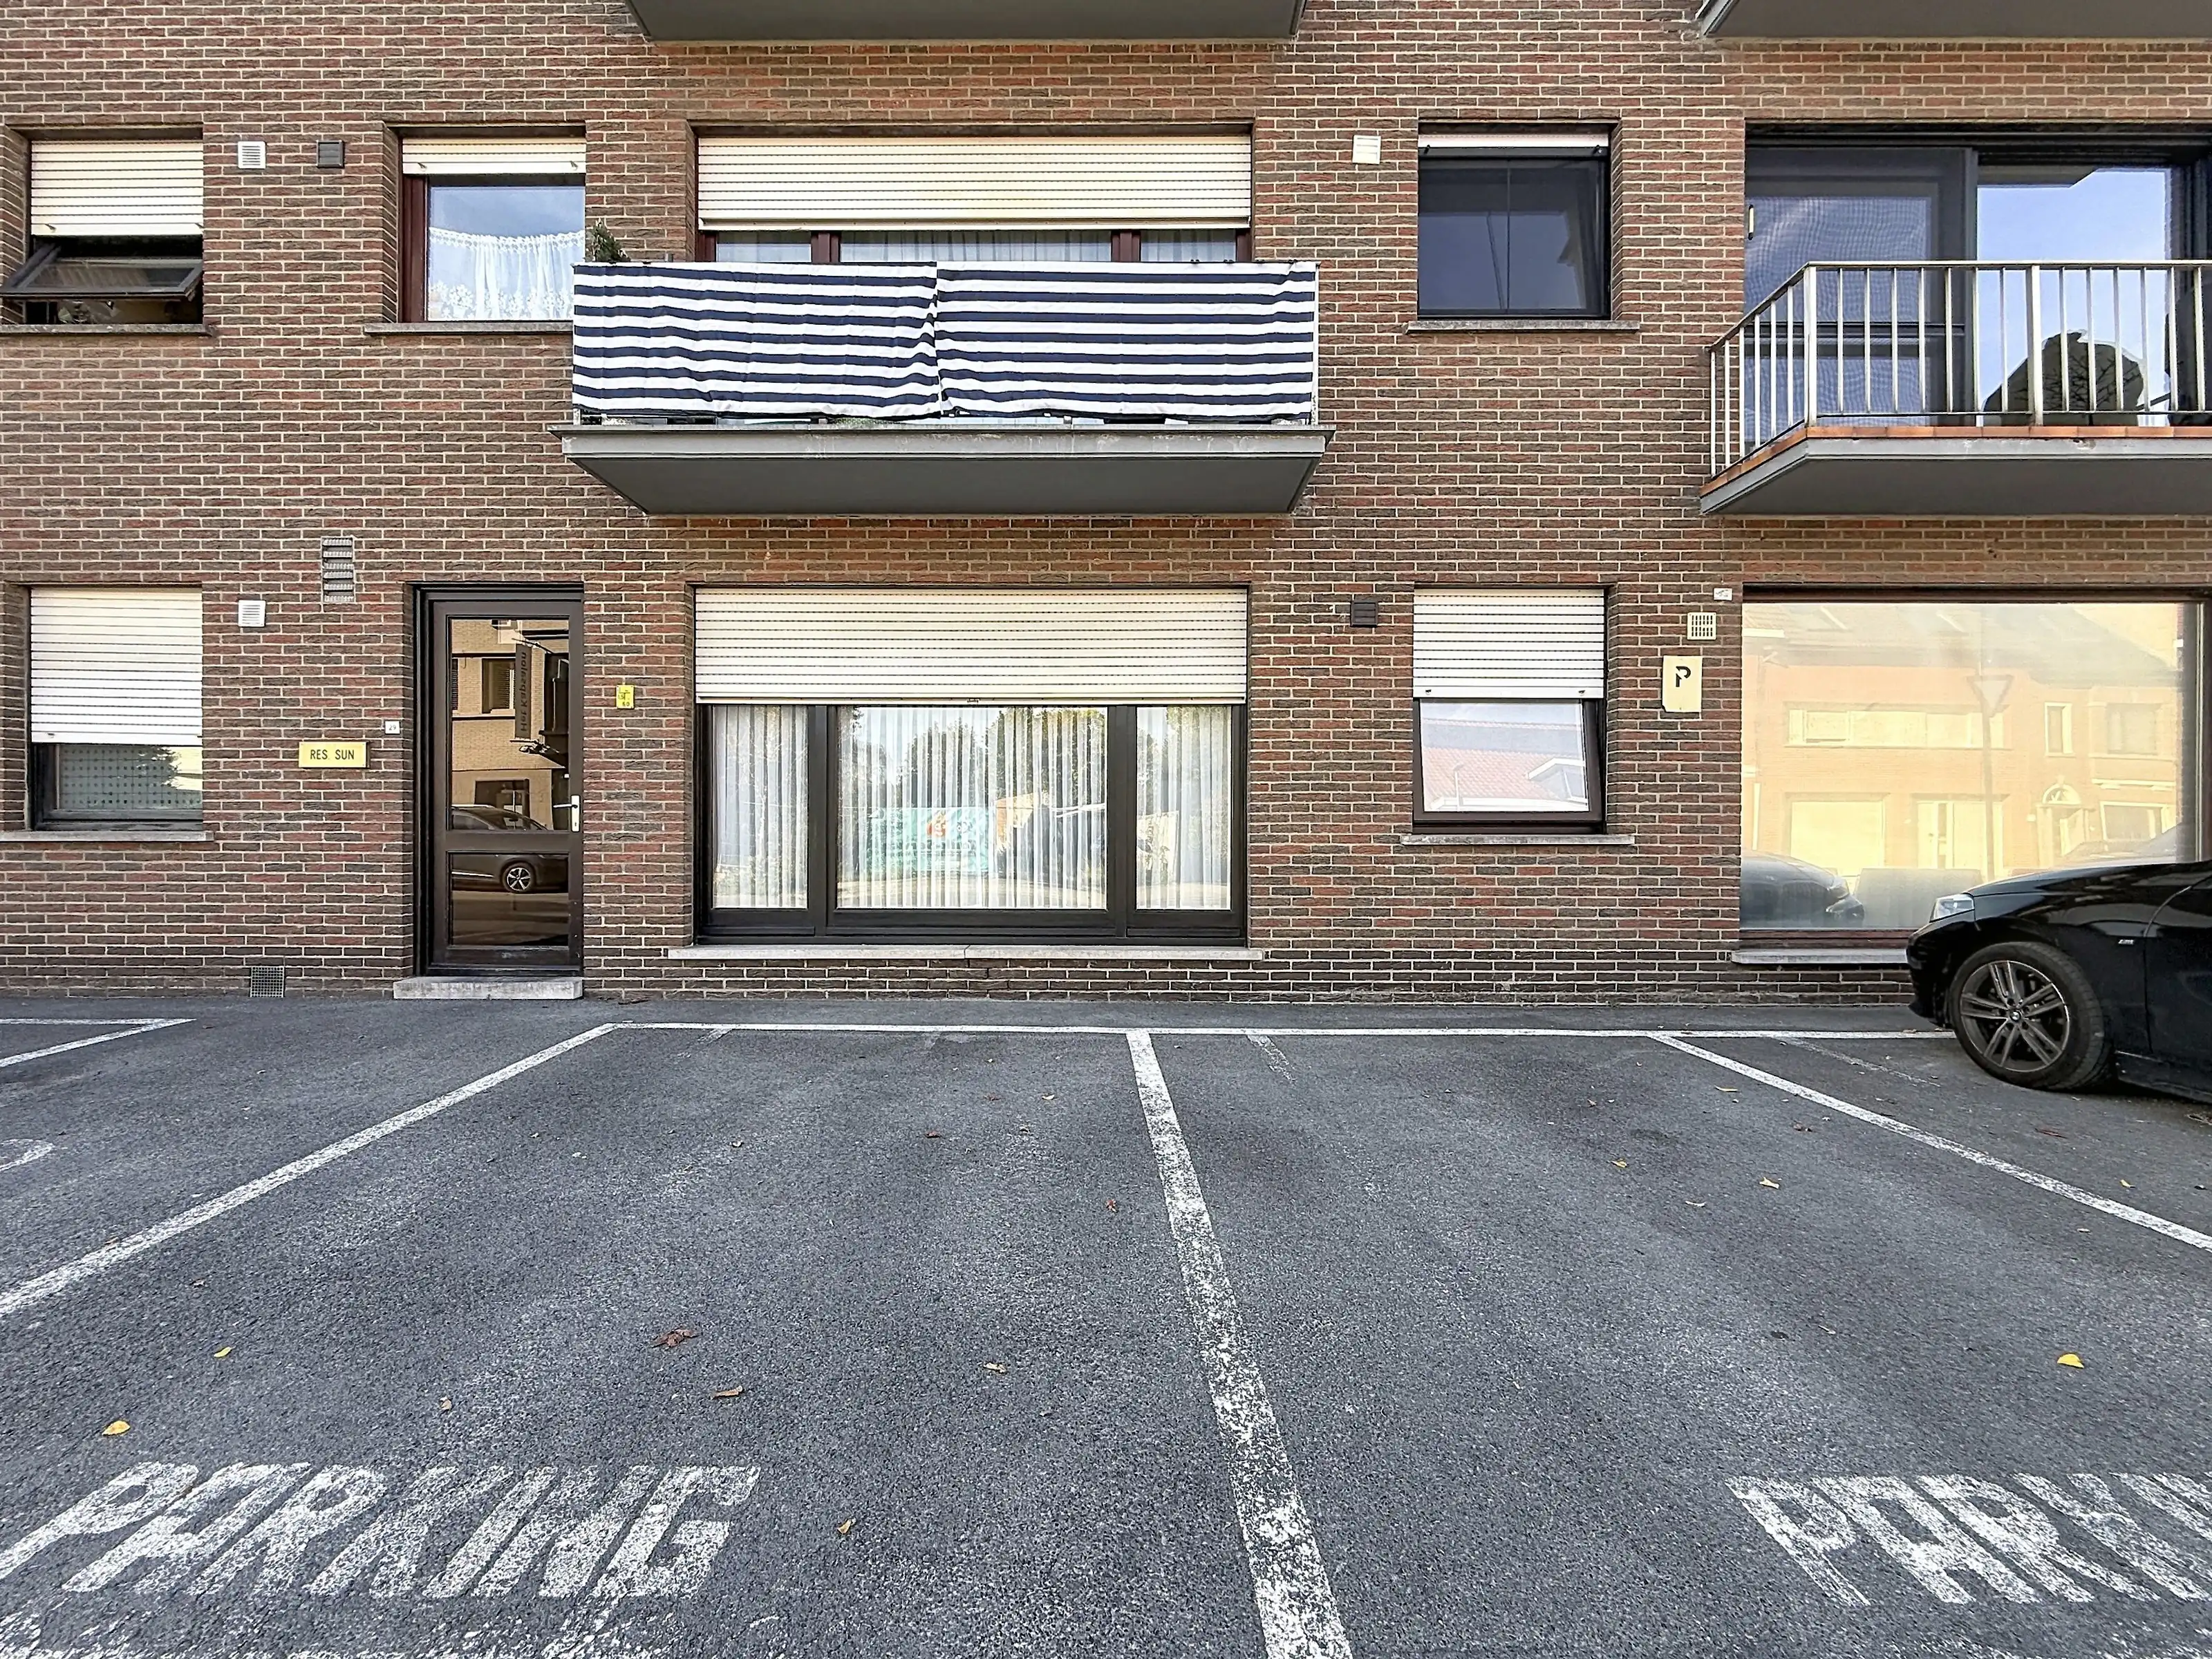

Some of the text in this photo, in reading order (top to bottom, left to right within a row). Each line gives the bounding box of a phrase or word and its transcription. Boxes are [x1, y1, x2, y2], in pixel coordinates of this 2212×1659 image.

[1675, 666, 1691, 688] P
[335, 749, 355, 760] SUN
[0, 1461, 762, 1600] PARKING
